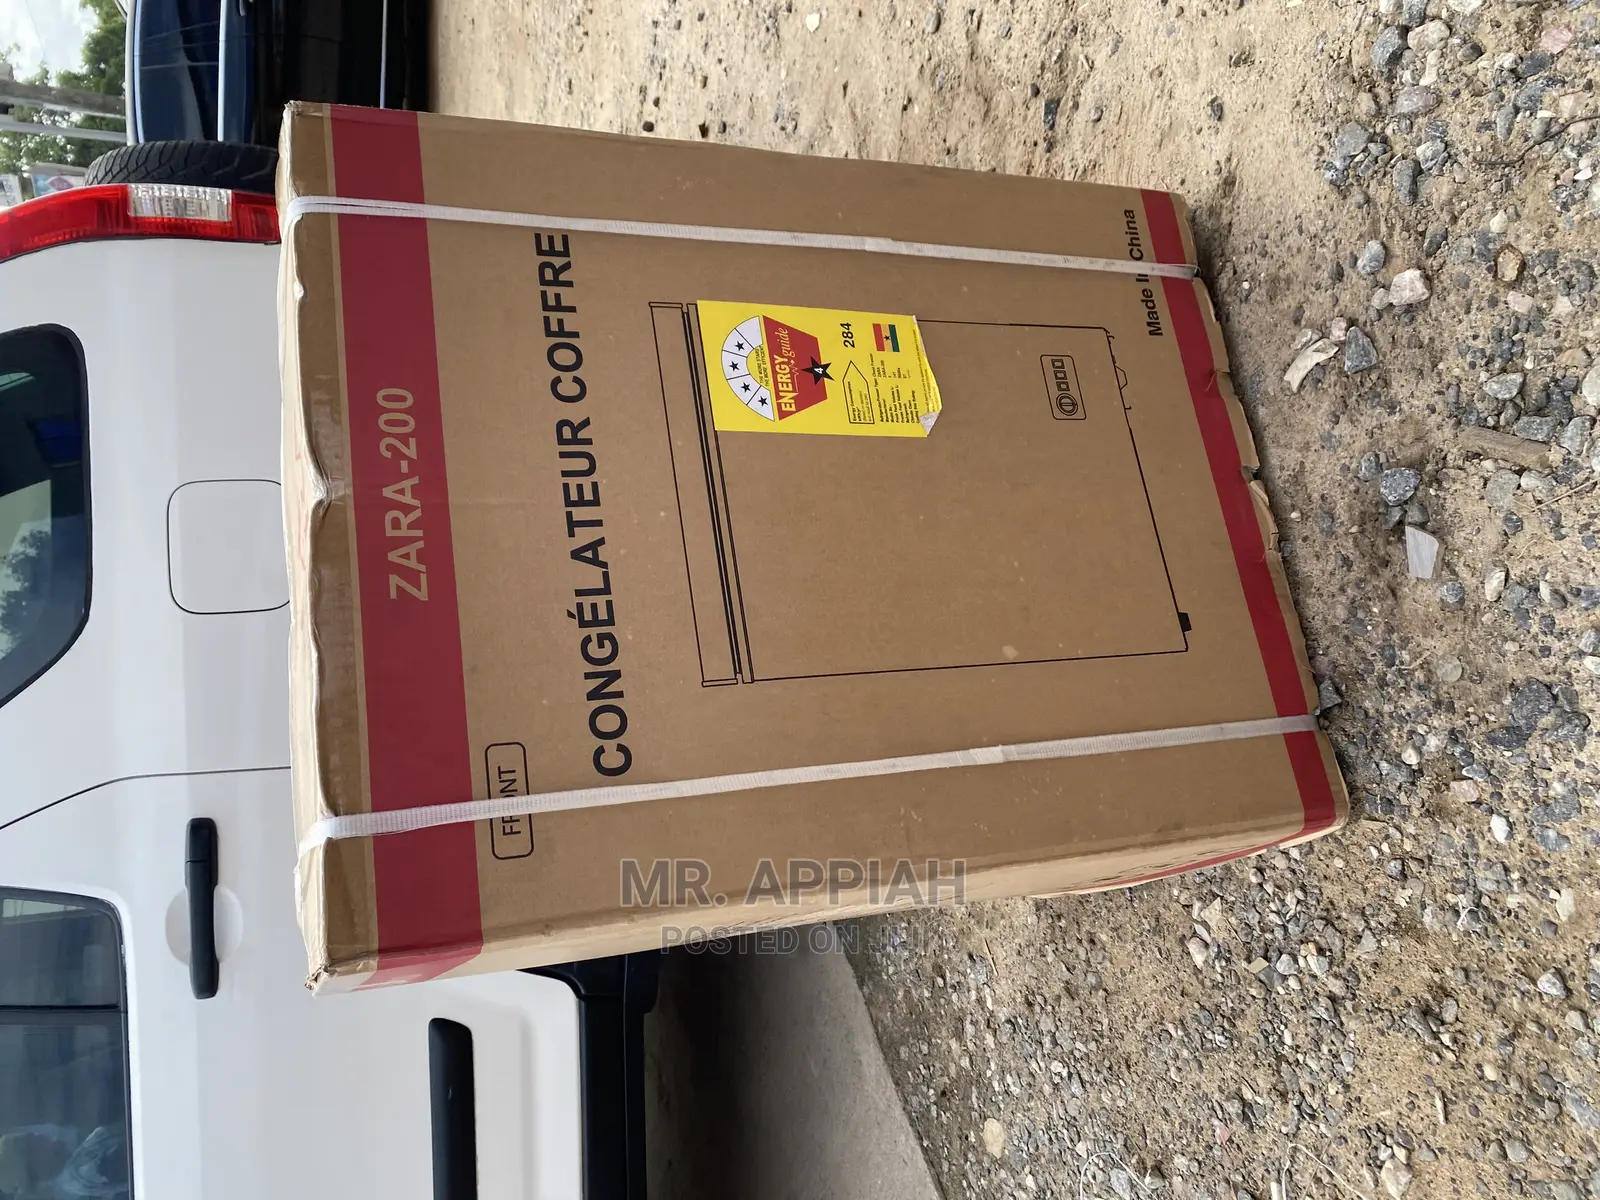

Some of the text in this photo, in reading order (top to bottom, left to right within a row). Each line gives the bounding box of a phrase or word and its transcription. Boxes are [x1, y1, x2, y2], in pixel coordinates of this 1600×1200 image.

[1124, 209, 1144, 261] China
[840, 322, 855, 348] 284
[1141, 288, 1163, 336] Made
[774, 327, 799, 412] ENERGY guide
[376, 388, 428, 601] ZARA-200
[534, 233, 632, 777] CONGÉLATEUR COFFRE
